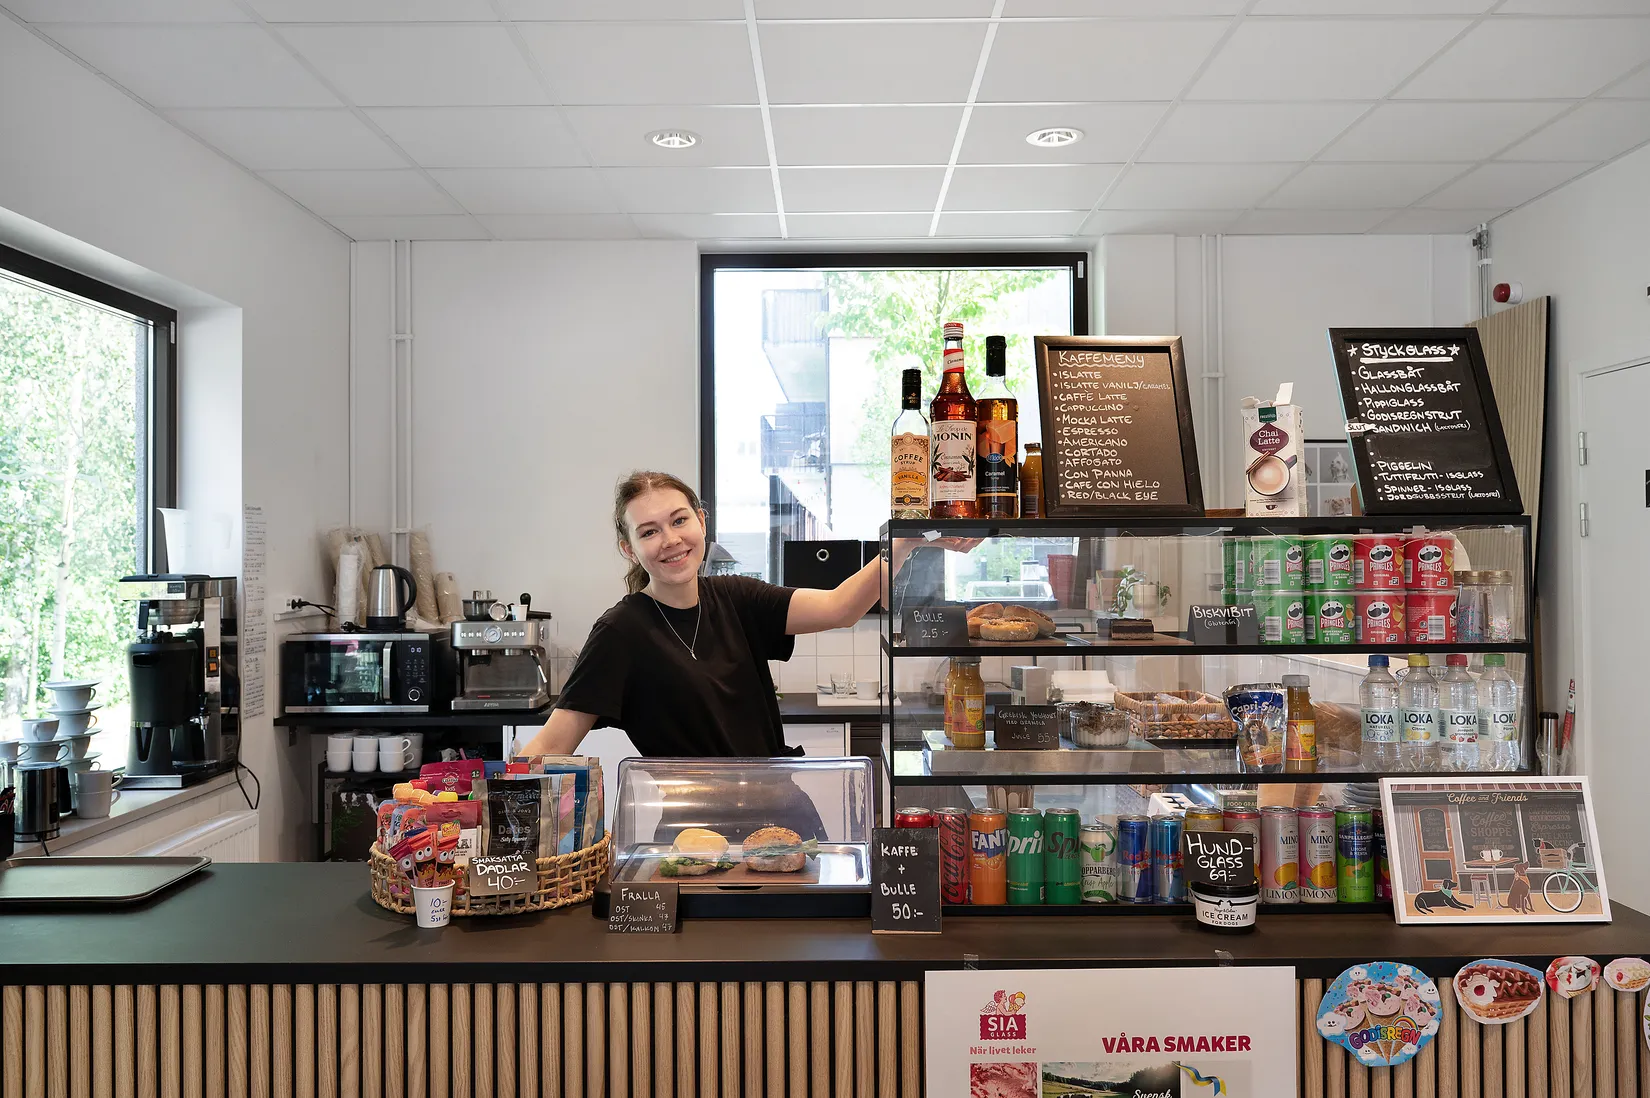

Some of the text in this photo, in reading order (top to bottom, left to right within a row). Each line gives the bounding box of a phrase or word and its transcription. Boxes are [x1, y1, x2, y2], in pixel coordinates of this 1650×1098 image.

[1058, 351, 1145, 368] KAFFEMENY
[1059, 371, 1102, 380] ISLATTE
[1358, 366, 1424, 380] GLASSBÅT
[1060, 381, 1099, 390] ISLATTE
[1362, 381, 1461, 394] HALLONGLASSBÅT
[1098, 393, 1127, 401] LATTE
[1060, 404, 1124, 412] CAPPUCCINO
[1363, 397, 1425, 409] PIPPIGLASS
[1062, 414, 1132, 425] MOCKA LATTE
[1366, 409, 1462, 421] GODISREGNSTRUT
[1063, 427, 1119, 436] ESPRESSO
[1258, 429, 1279, 438] Chai
[1063, 438, 1128, 447] AMERICANO
[1257, 437, 1280, 446] Latte
[1065, 448, 1118, 457] CORTADO
[894, 454, 923, 464] COFFEE
[1065, 458, 1122, 467] AFFOGATO
[1376, 461, 1432, 471] PIGGELIN
[1061, 469, 1133, 479] CON PANNA
[1446, 471, 1484, 479] ISGLASS
[1065, 480, 1160, 489] CAFE CON HIELO
[1435, 484, 1472, 492] ISGLASS
[1068, 490, 1158, 500] RED/BLACK EYE
[1369, 561, 1393, 572] PRINGLES
[1418, 561, 1442, 572] PRINGLES
[914, 610, 944, 623] BULLE
[1193, 606, 1253, 619] BISKVIBIT
[1320, 617, 1344, 629] PRINGLES
[1367, 618, 1391, 629] PRINGLES
[1231, 701, 1282, 716] Capri-Sun
[1366, 714, 1394, 724] LOKA
[1405, 713, 1433, 723] LOKA
[1450, 715, 1477, 725] LOKA
[1447, 792, 1476, 804] Coffee
[1491, 792, 1529, 804] Friends
[1471, 827, 1512, 837] SHOPPE
[1006, 830, 1043, 858] prit
[1310, 835, 1333, 844] MINO
[880, 842, 918, 857] KAFFE
[471, 854, 524, 864] SMAKSATTA
[1197, 855, 1244, 869] GLASS
[476, 862, 531, 876] DADLAR
[898, 864, 905, 874] +
[1209, 869, 1237, 882] 69:-
[487, 875, 526, 891] 40:-
[621, 887, 660, 901] FRALLA
[880, 882, 917, 896] BULLE
[615, 905, 630, 913] OST
[892, 902, 924, 919] 50:-
[1202, 911, 1248, 921] ICE CREAM
[987, 1016, 1019, 1032] SIA
[1102, 1031, 1252, 1054] VÅRA SMAKER
[970, 1045, 1037, 1056] När livet leker
